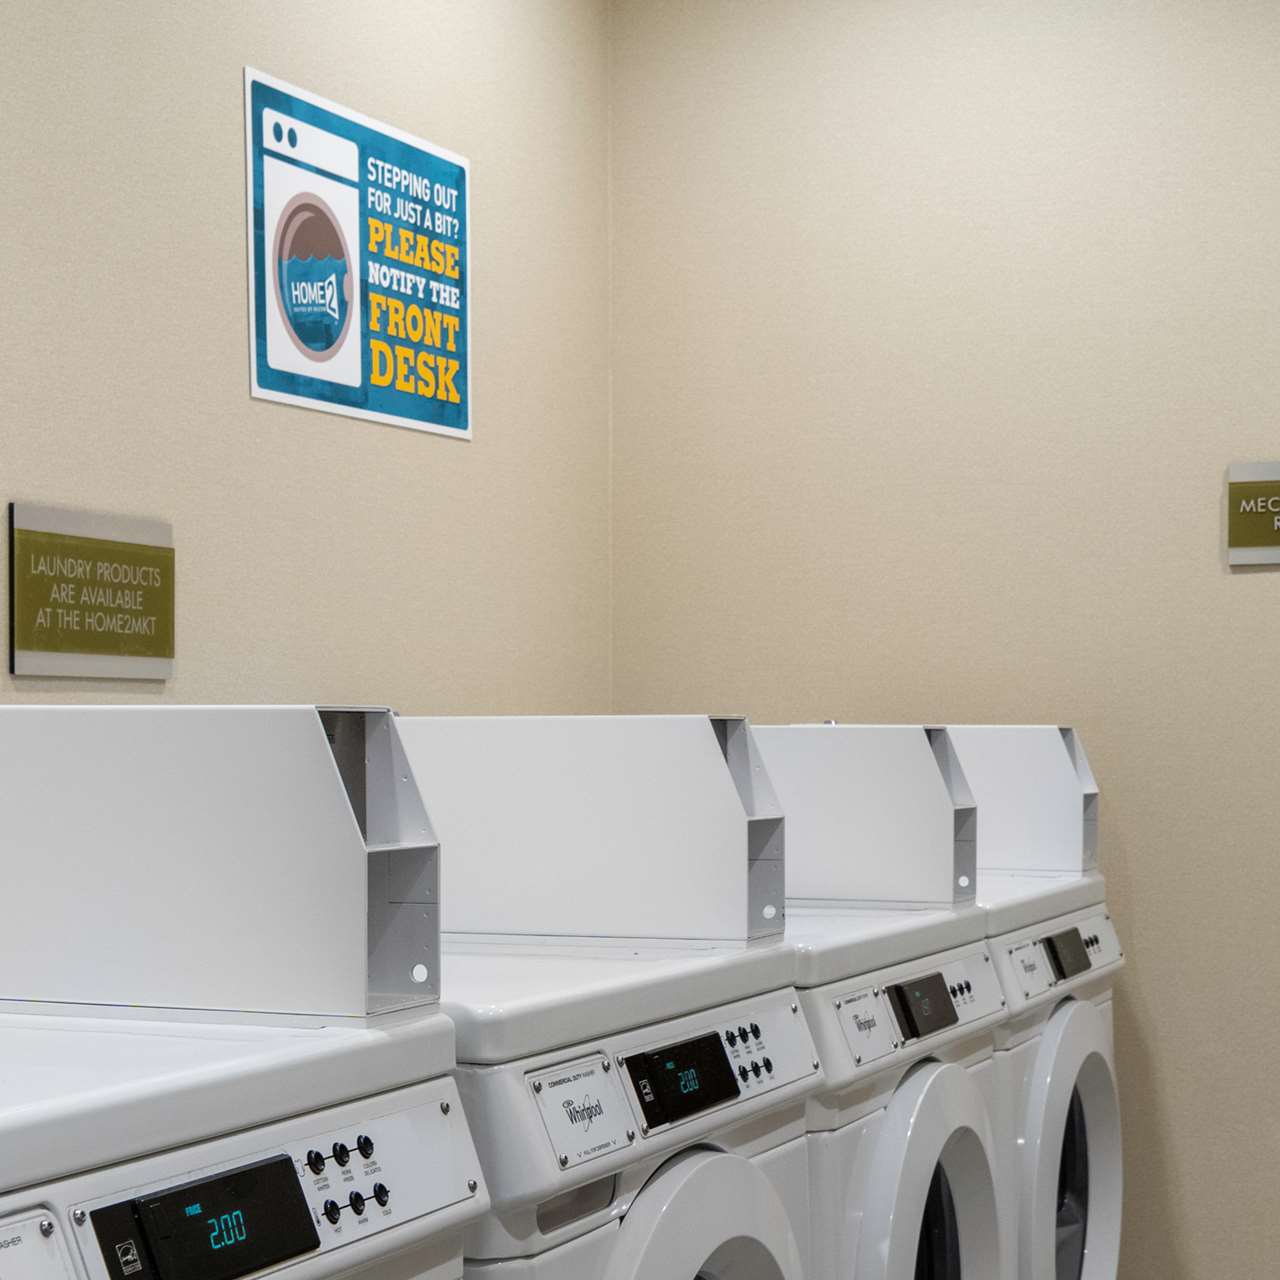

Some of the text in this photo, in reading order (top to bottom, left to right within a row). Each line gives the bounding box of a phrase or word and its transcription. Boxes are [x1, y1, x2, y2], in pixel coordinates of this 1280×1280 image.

[367, 156, 458, 212] STEPPING OUT
[367, 186, 460, 239] FOR JUST A BIT?
[367, 217, 460, 279] PLEASE
[368, 261, 460, 309] NOTIFY THE
[368, 291, 460, 352] FRONT
[370, 338, 461, 403] DESK
[31, 554, 161, 587] LAUNDRY PRODUCTS
[36, 608, 157, 635] AT THE HOME2MKT
[50, 583, 143, 610] ARE AVAILABLE
[207, 1209, 247, 1249] 2.00
